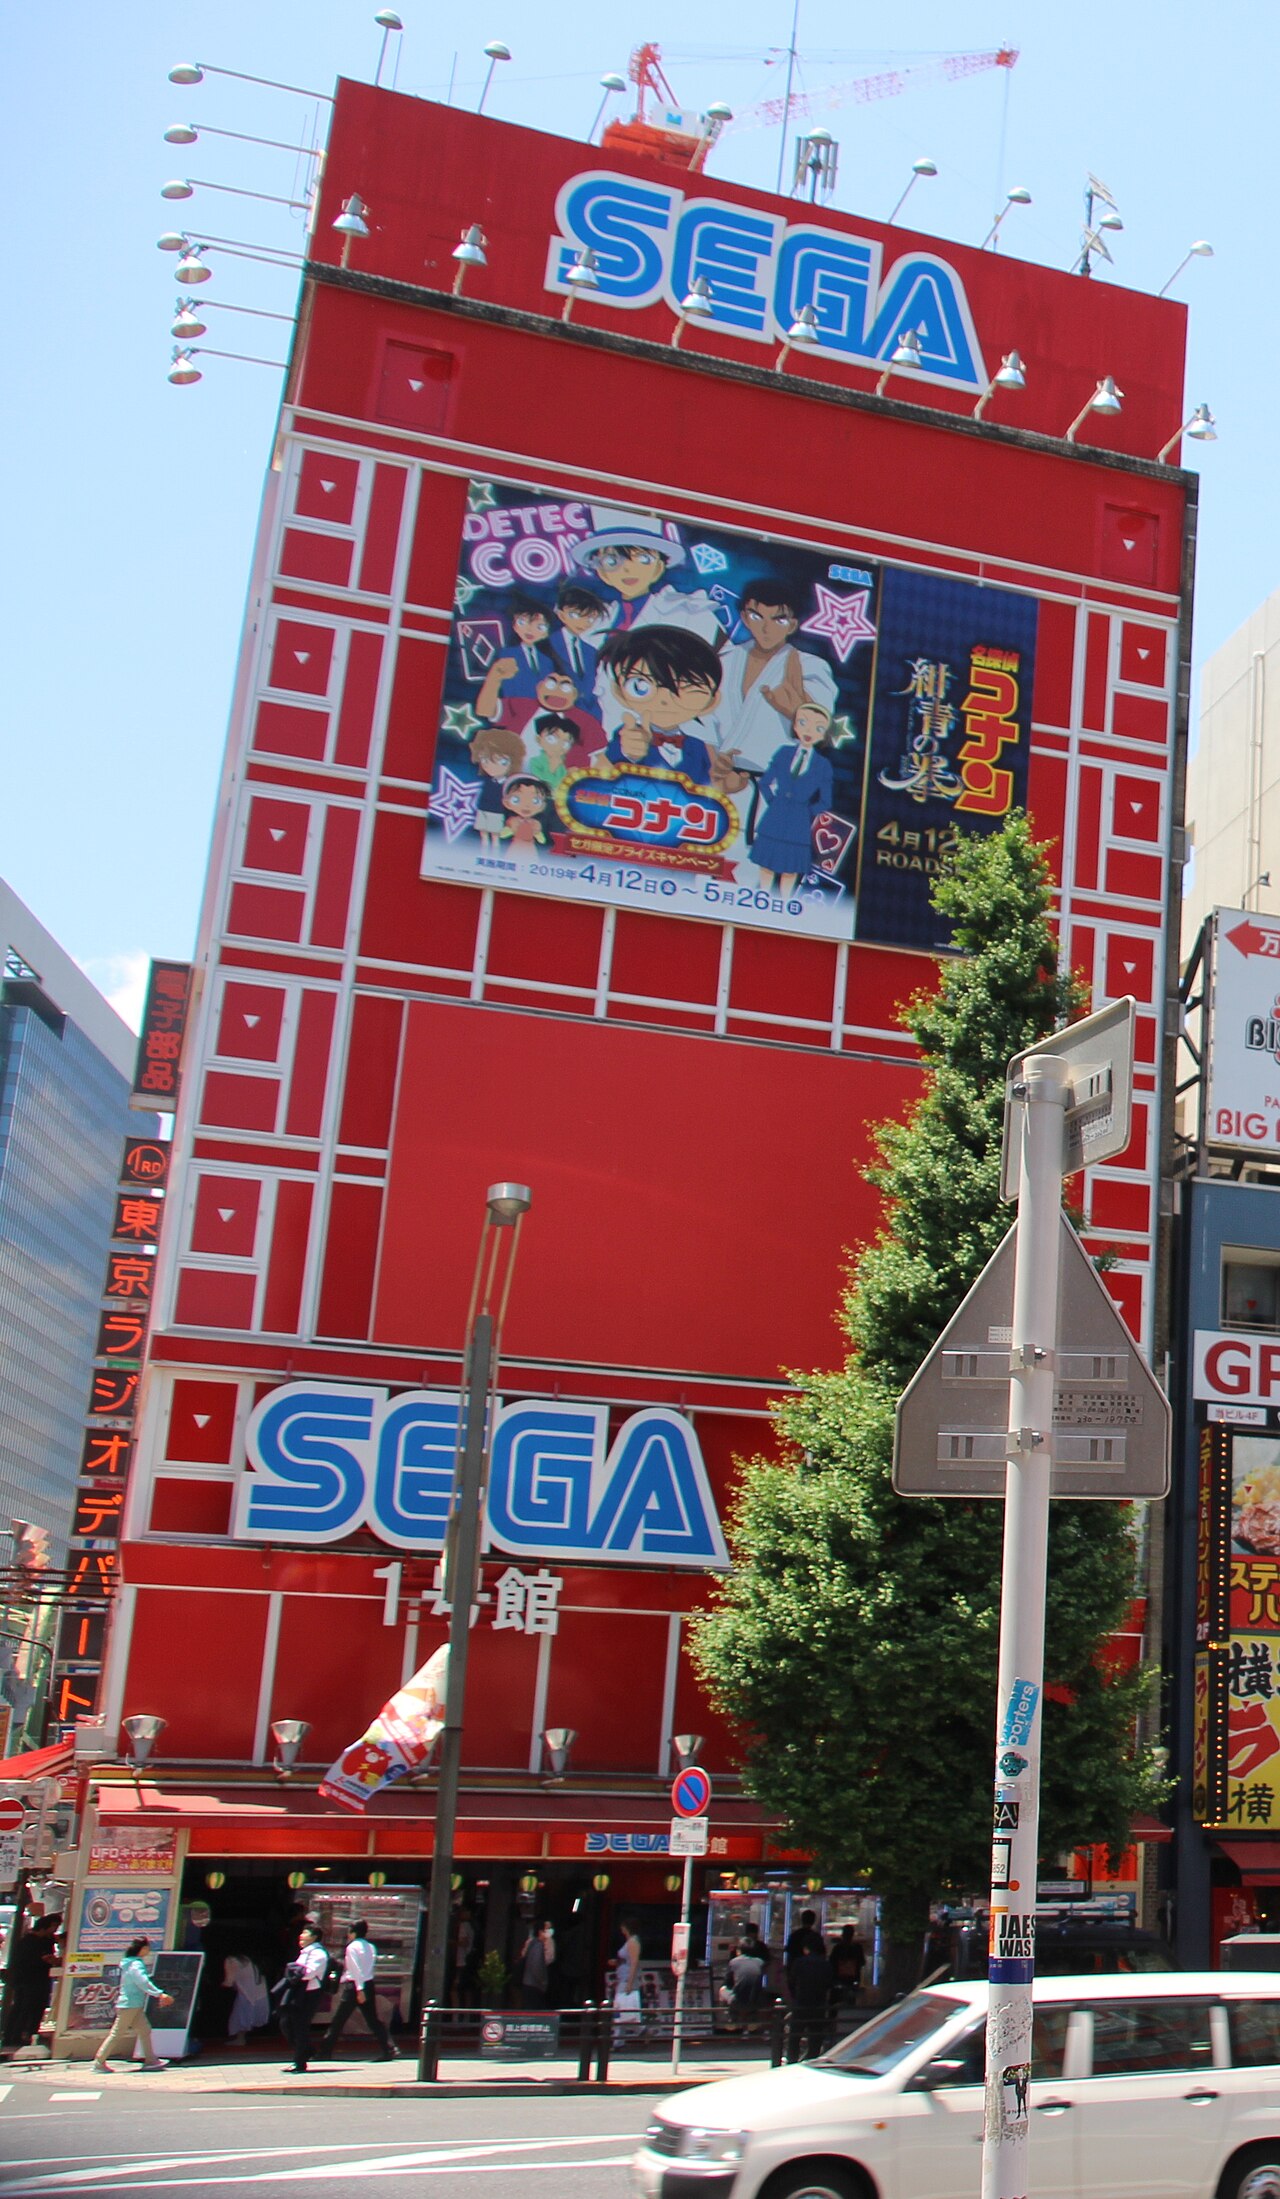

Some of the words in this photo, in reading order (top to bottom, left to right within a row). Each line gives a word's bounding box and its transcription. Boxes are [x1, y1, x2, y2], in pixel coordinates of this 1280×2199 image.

[546, 172, 988, 394] SEGA
[463, 503, 590, 542] DETEC
[828, 564, 874, 587] SEGA
[954, 666, 1020, 816] コナン
[603, 795, 720, 842] コナン
[876, 820, 957, 856] 4月12
[876, 848, 960, 876] ROADS
[1245, 1014, 1280, 1053] BI
[1216, 1108, 1268, 1140] BIG
[236, 1381, 731, 1567] SEGA
[1196, 1623, 1211, 1640] 2F
[1228, 1783, 1275, 1825] 横
[999, 1939, 1032, 1958] WAS
